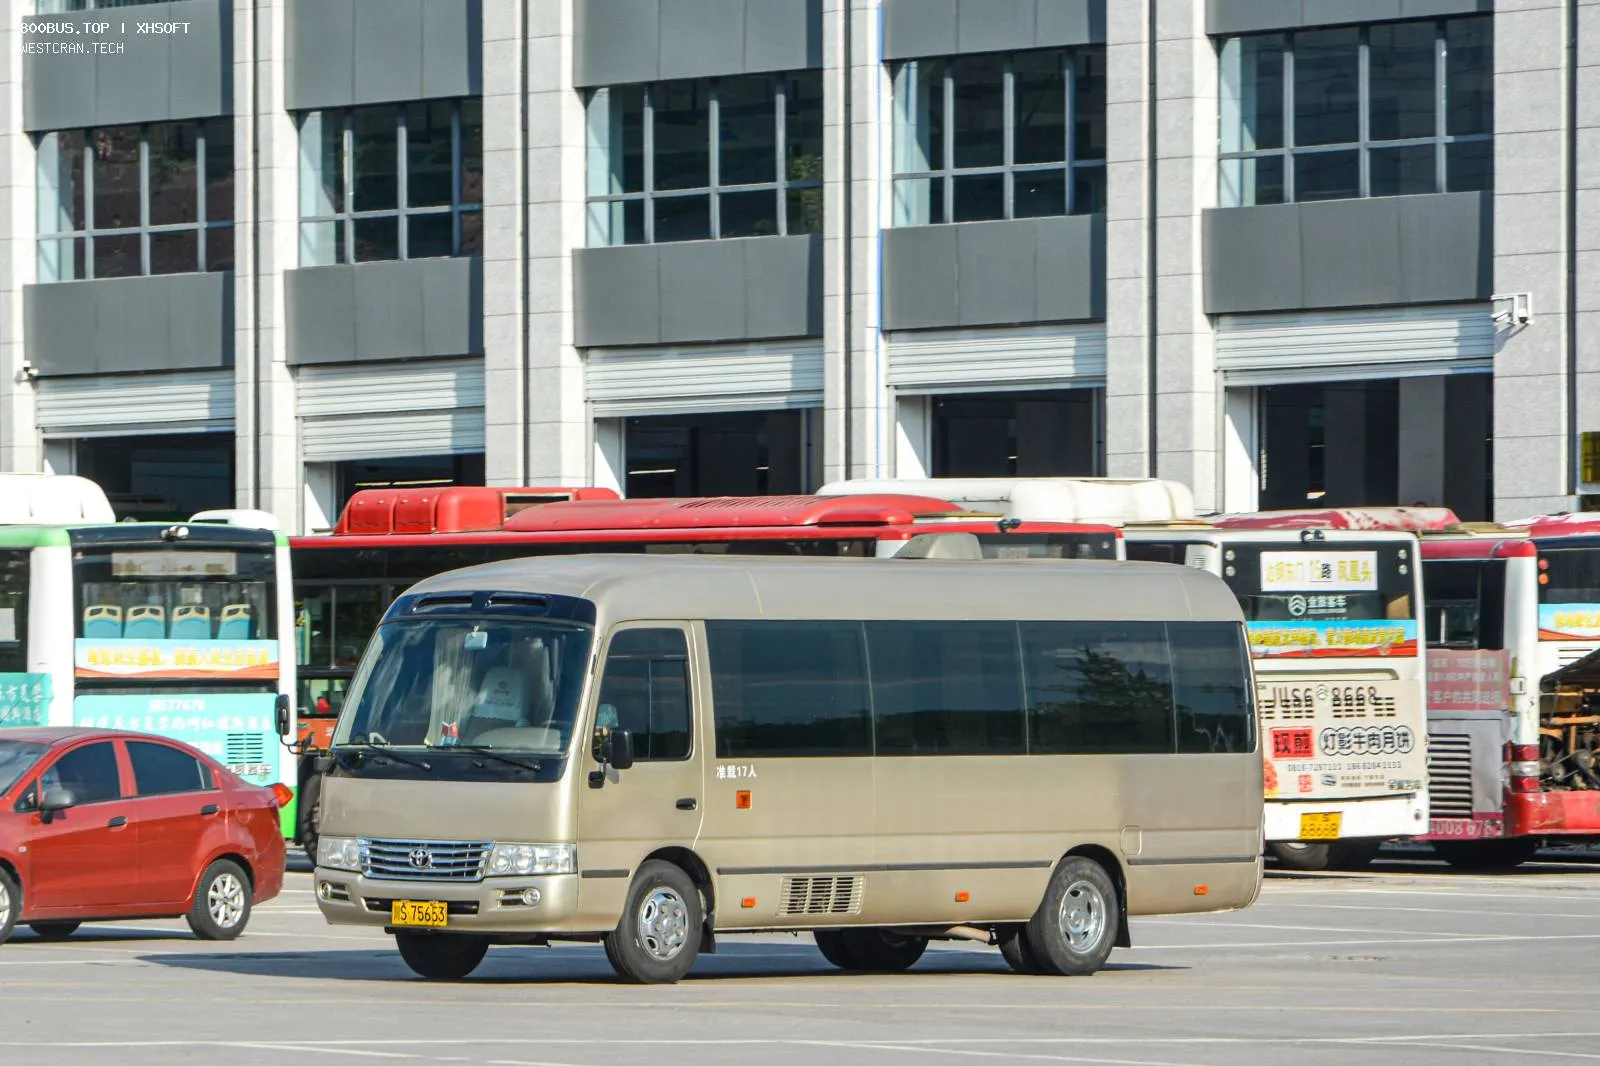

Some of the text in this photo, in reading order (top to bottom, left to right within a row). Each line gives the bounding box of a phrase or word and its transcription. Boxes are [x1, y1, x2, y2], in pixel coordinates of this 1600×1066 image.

[1323, 730, 1410, 751] 灯影牛肉月饼
